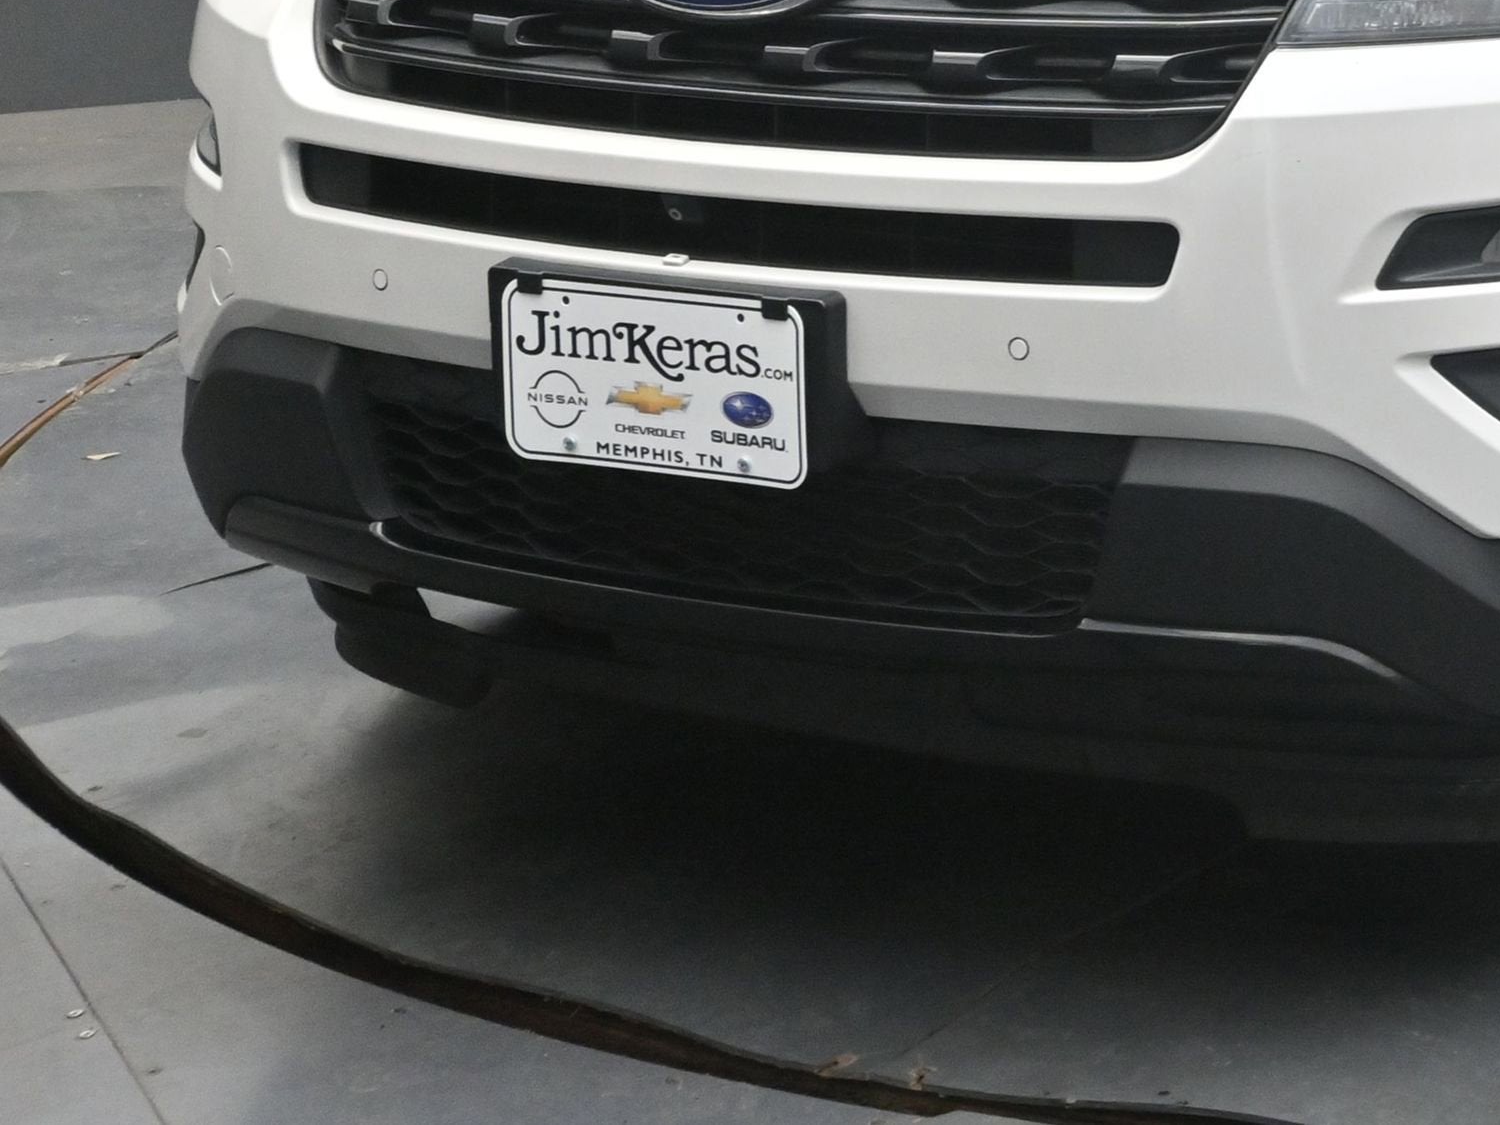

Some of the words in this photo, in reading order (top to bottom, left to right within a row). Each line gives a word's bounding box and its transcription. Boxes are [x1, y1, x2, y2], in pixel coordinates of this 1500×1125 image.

[527, 393, 588, 406] NISSAN
[615, 424, 686, 439] CHEVROLET
[711, 430, 786, 452] SUBARU
[596, 442, 690, 467] MEMPHIS,
[696, 454, 724, 468] TN
